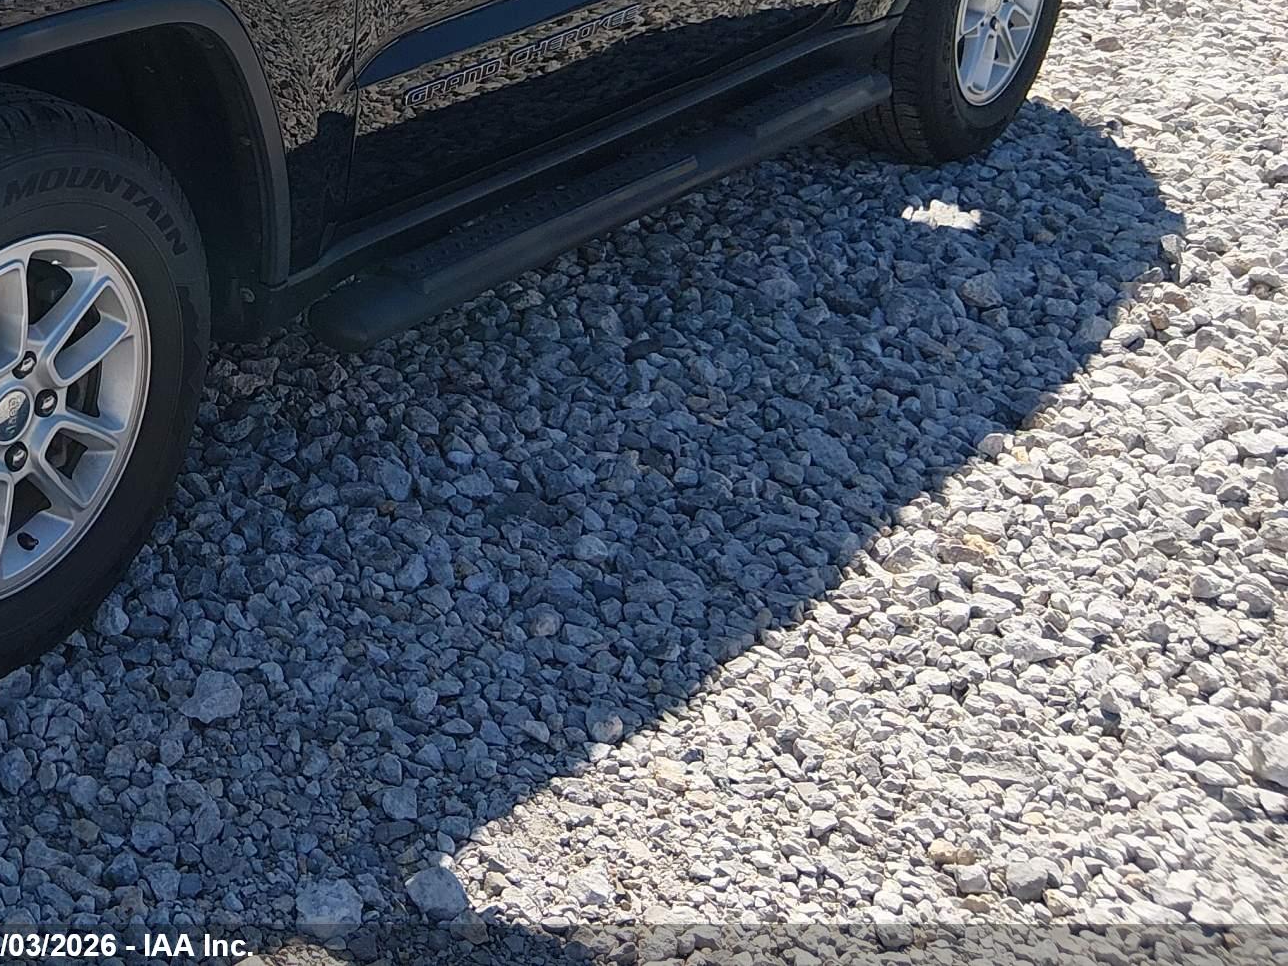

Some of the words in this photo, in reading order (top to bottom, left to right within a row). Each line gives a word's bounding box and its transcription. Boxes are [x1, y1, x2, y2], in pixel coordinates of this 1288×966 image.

[406, 58, 503, 107] GRAND
[510, 5, 642, 67] CHEROKEE
[3, 166, 189, 257] MOUNTAIN
